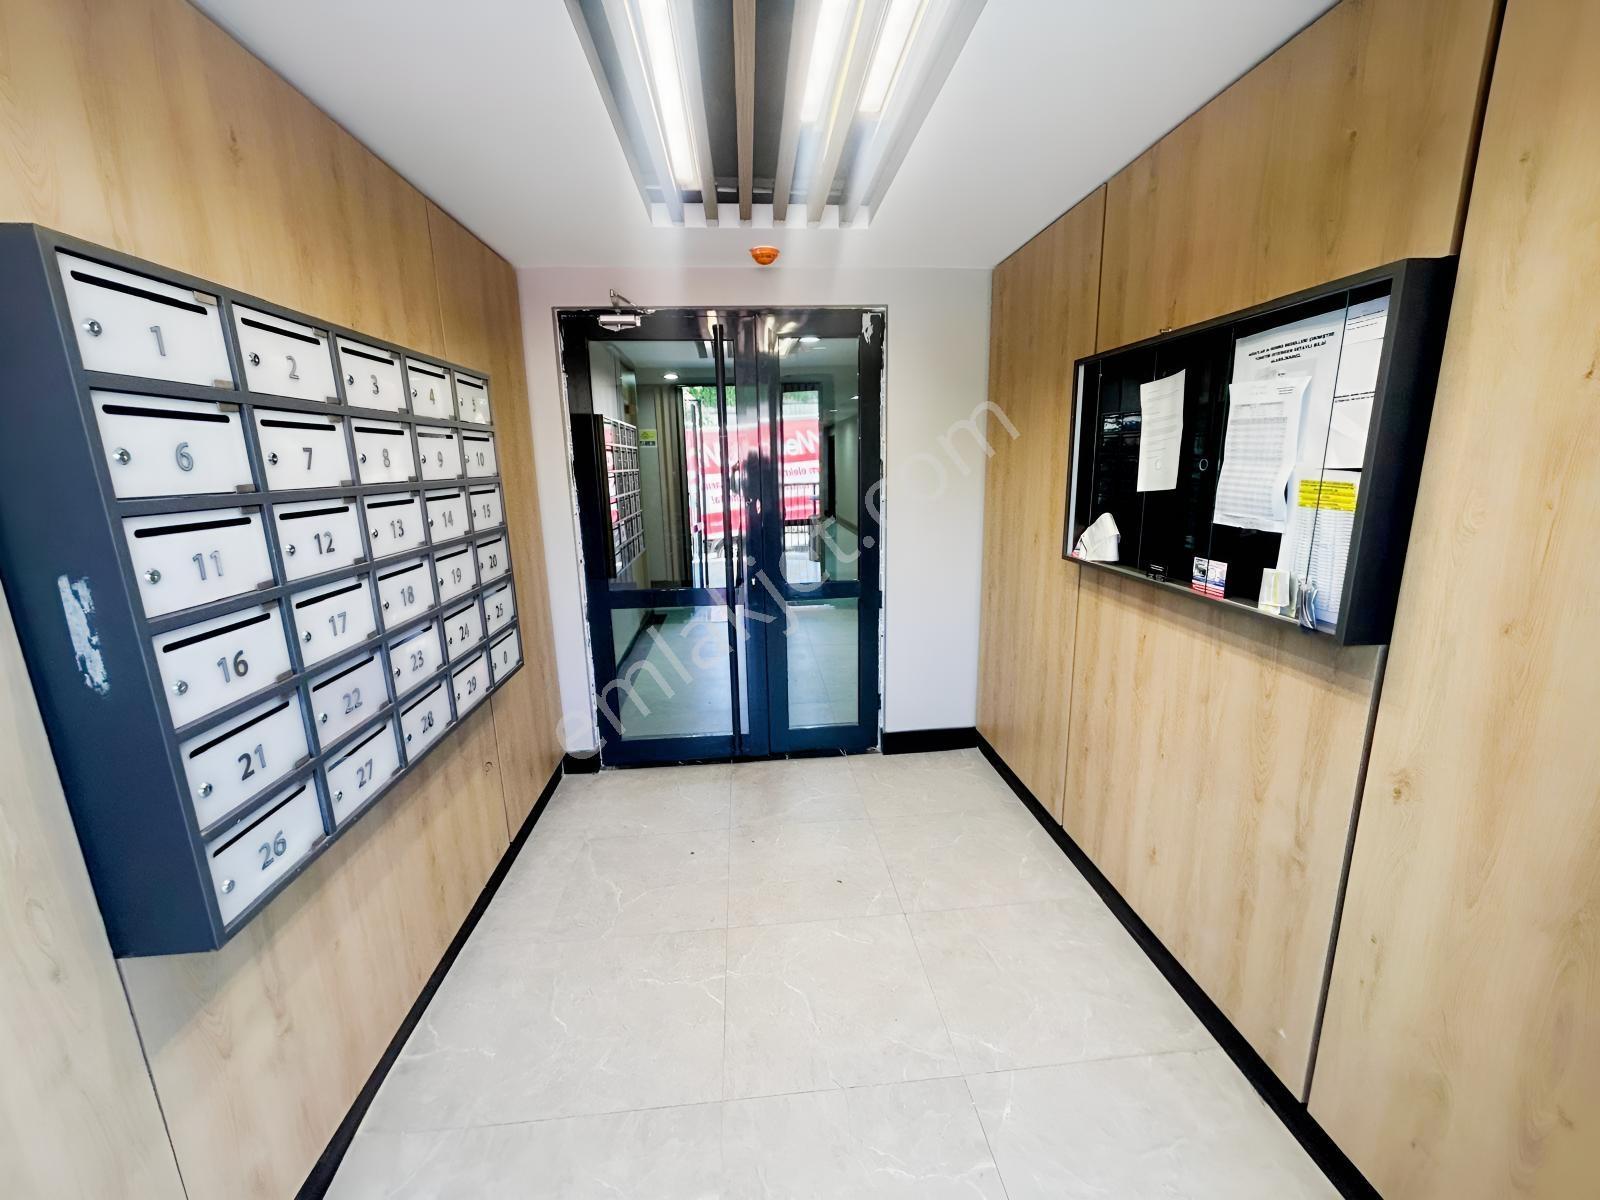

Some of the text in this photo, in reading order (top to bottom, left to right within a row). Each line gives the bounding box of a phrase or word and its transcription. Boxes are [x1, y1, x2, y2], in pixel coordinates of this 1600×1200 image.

[150, 326, 166, 356] 1
[286, 355, 300, 380] 2
[370, 374, 380, 395] 3
[429, 387, 436, 405] 4
[175, 442, 194, 472] 6
[302, 447, 313, 470] 7
[382, 448, 391, 468] 8
[437, 450, 444, 468] 9
[475, 450, 485, 467] 10
[441, 510, 454, 528] 14
[482, 504, 491, 519] 15
[390, 519, 405, 539] 13
[313, 531, 336, 555] 12
[192, 550, 223, 581] 11
[488, 554, 498, 569] 20
[451, 567, 462, 584] 19
[400, 585, 415, 607] 18
[495, 603, 504, 619] 25
[328, 611, 347, 636] 17
[458, 623, 470, 641] 24
[217, 650, 249, 683] 16
[410, 649, 424, 672] 23
[466, 676, 477, 695] 29
[342, 687, 363, 715] 22
[420, 710, 434, 734] 28
[238, 743, 267, 781] 21
[356, 758, 373, 789] 27
[258, 830, 287, 870] 26
